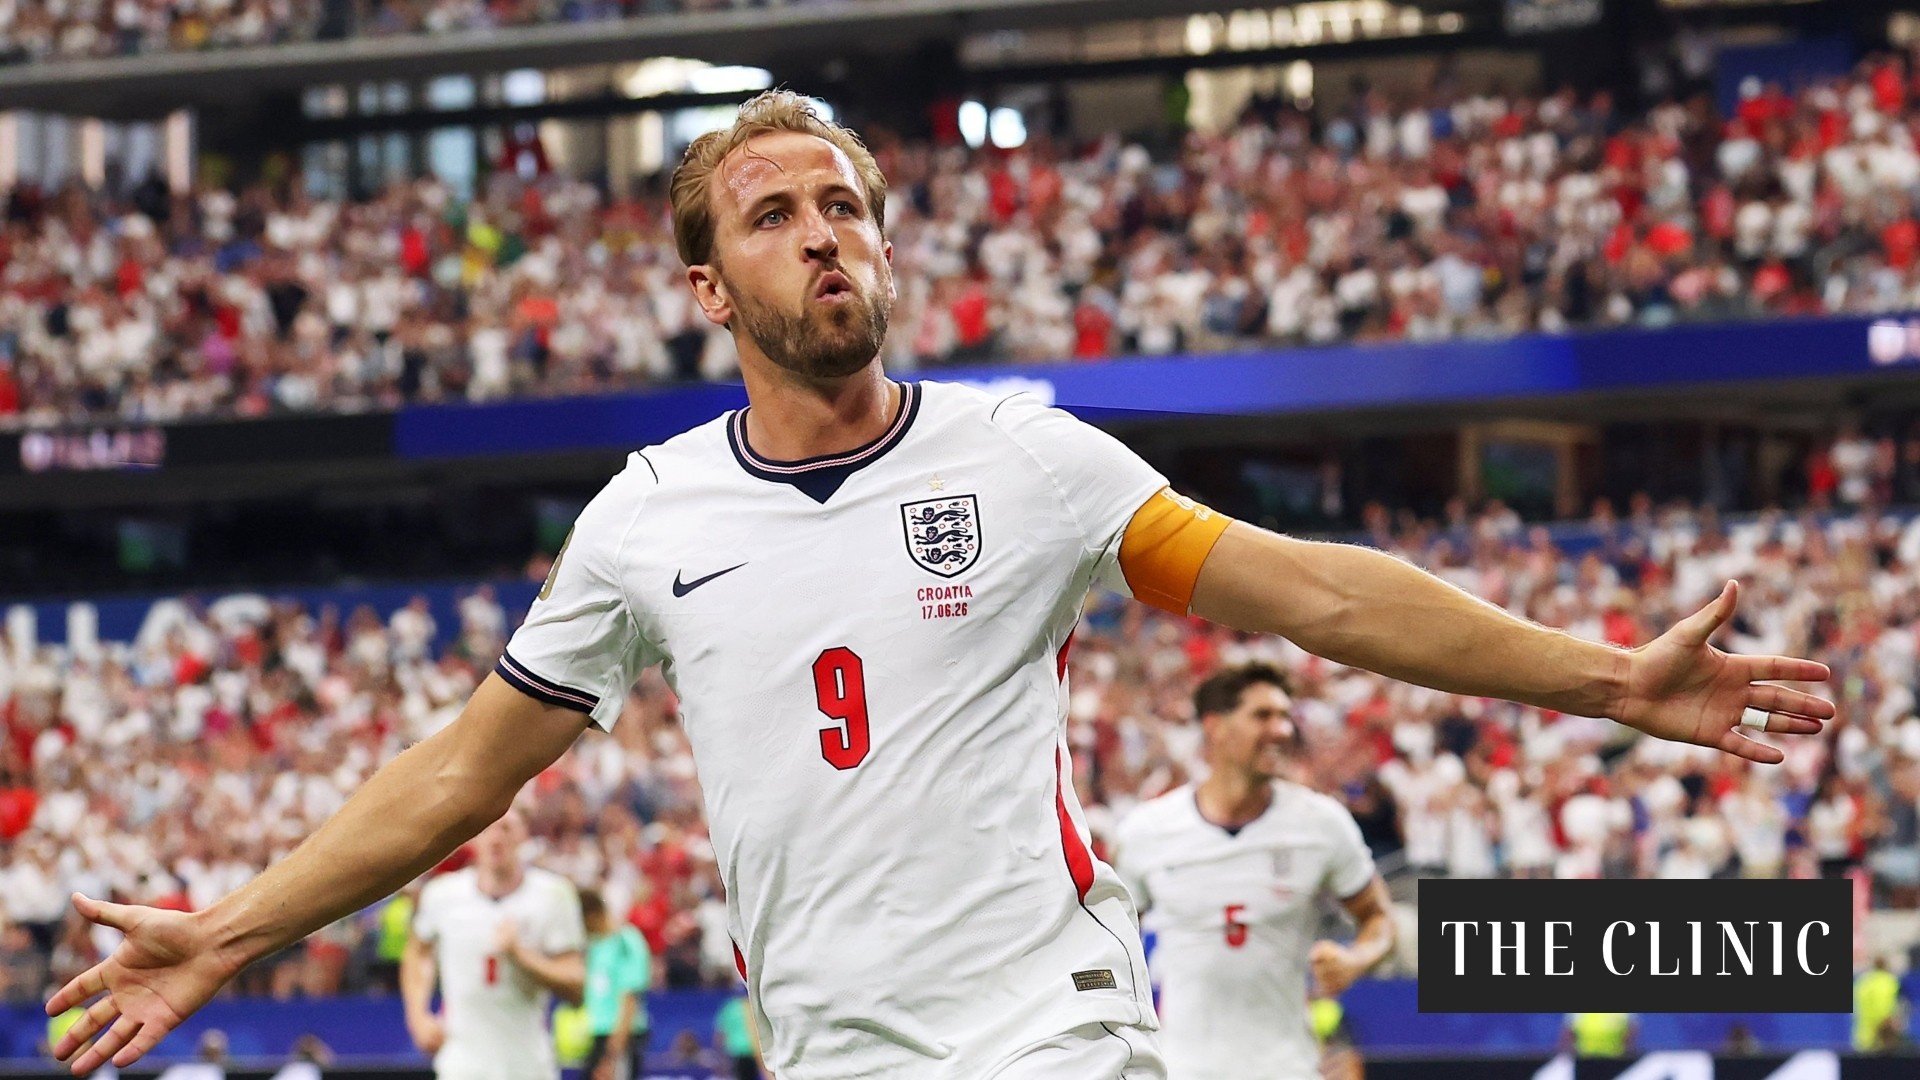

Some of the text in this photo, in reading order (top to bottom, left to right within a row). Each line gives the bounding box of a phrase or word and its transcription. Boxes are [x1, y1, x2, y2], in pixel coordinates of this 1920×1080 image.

[917, 585, 973, 601] CROATIA
[922, 602, 968, 620] 17.06.26
[812, 646, 870, 770] 9
[1223, 903, 1248, 949] 5
